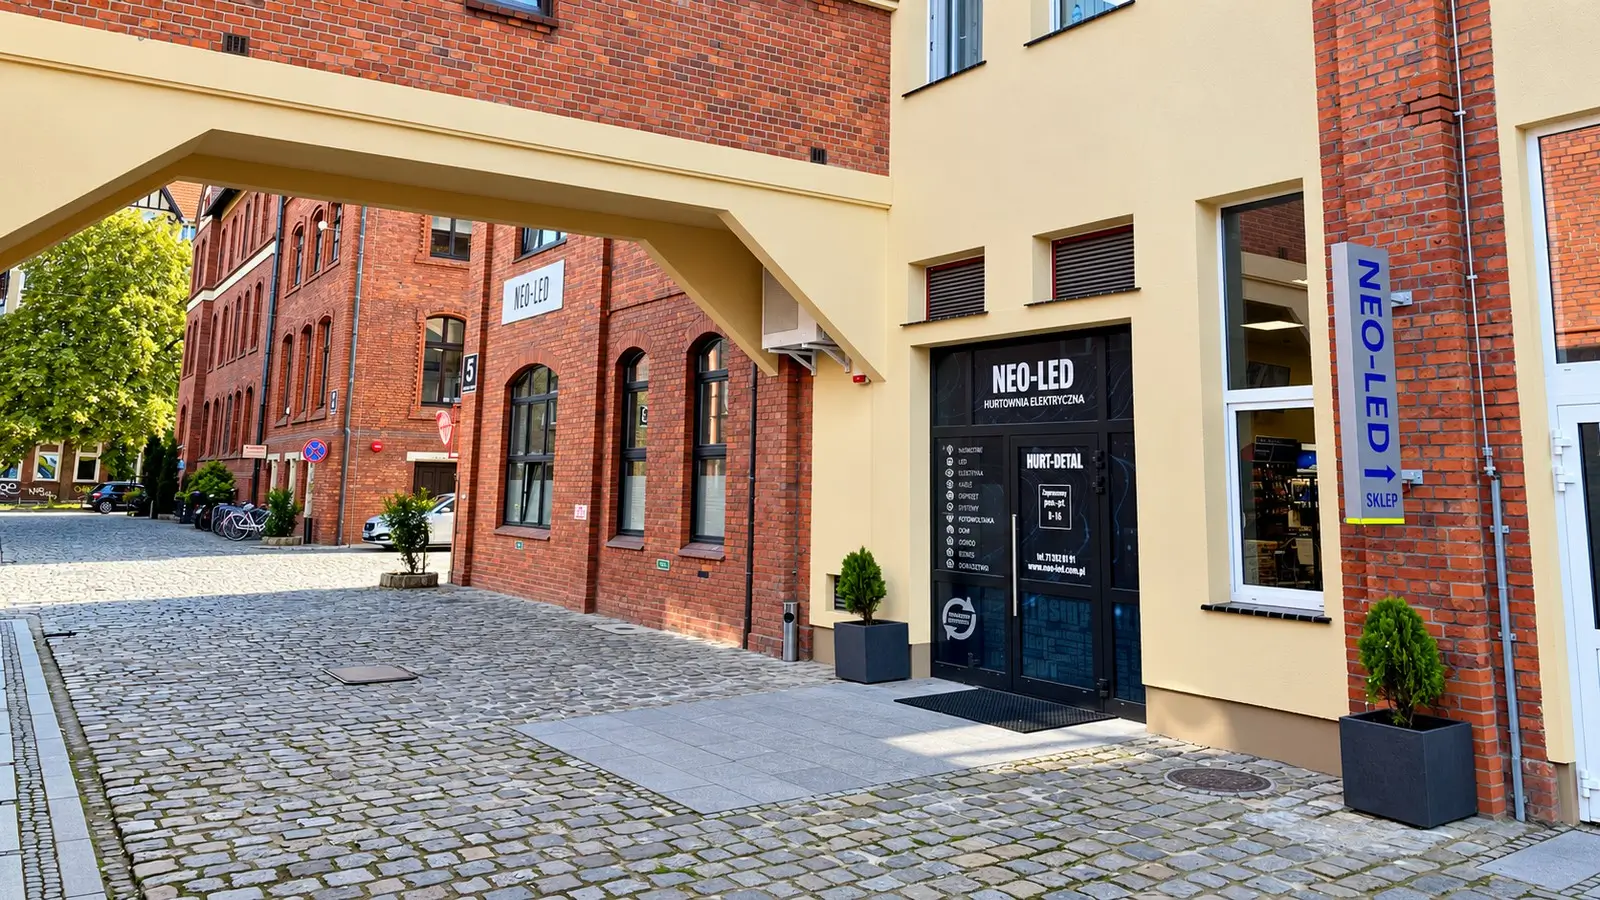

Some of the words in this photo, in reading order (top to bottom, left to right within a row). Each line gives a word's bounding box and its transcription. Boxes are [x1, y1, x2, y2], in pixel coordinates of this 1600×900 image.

[513, 276, 550, 311] NEO-LED
[1357, 258, 1391, 453] NEO-LED
[465, 358, 474, 382] 5
[992, 358, 1074, 394] NEO-LED
[984, 397, 1029, 409] HURTOWNIA
[1030, 394, 1085, 407] ELEKTRYCZNA
[1026, 453, 1083, 469] HURT-DETAL
[1366, 492, 1399, 508] SKLEP
